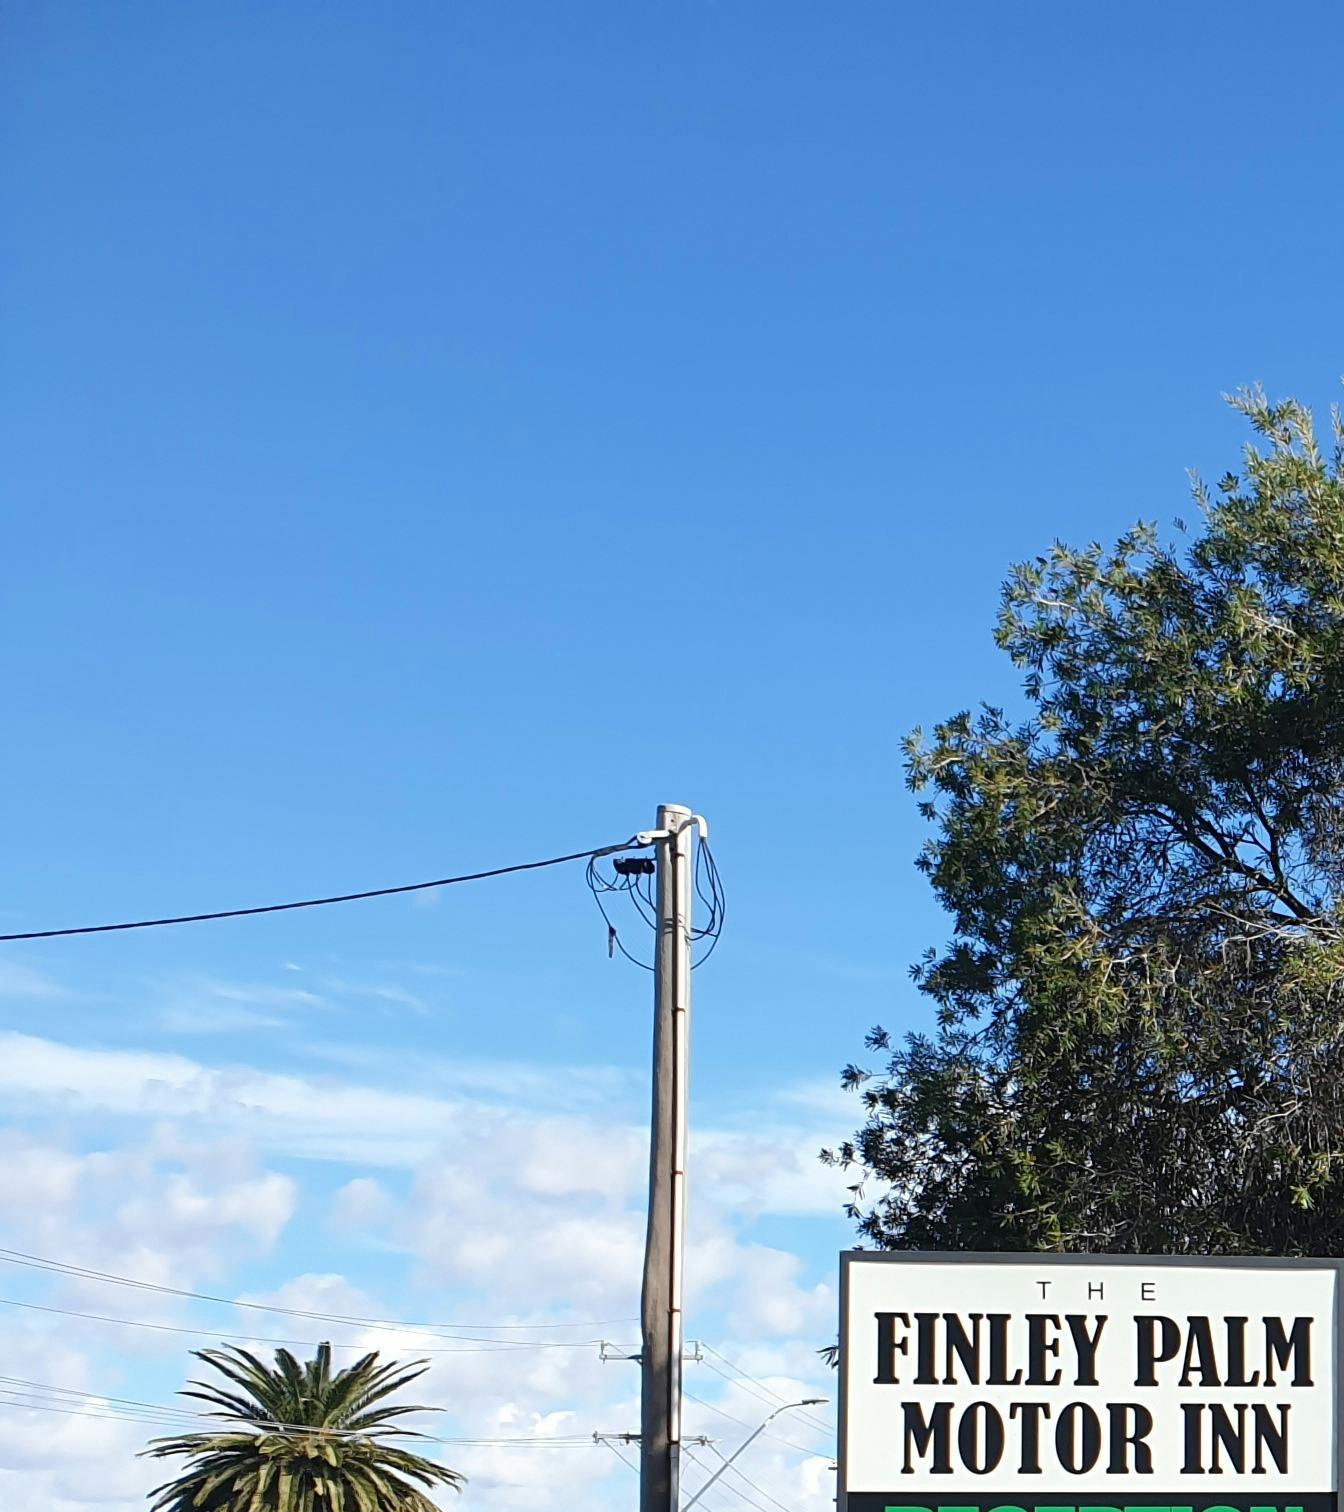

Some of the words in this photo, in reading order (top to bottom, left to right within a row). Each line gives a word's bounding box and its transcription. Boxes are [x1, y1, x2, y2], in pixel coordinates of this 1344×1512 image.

[1036, 1281, 1156, 1301] THE
[873, 1312, 1108, 1386] FINLEY
[1134, 1316, 1314, 1387] PALM
[901, 1401, 1153, 1474] MOTOR
[1180, 1404, 1291, 1474] INN
